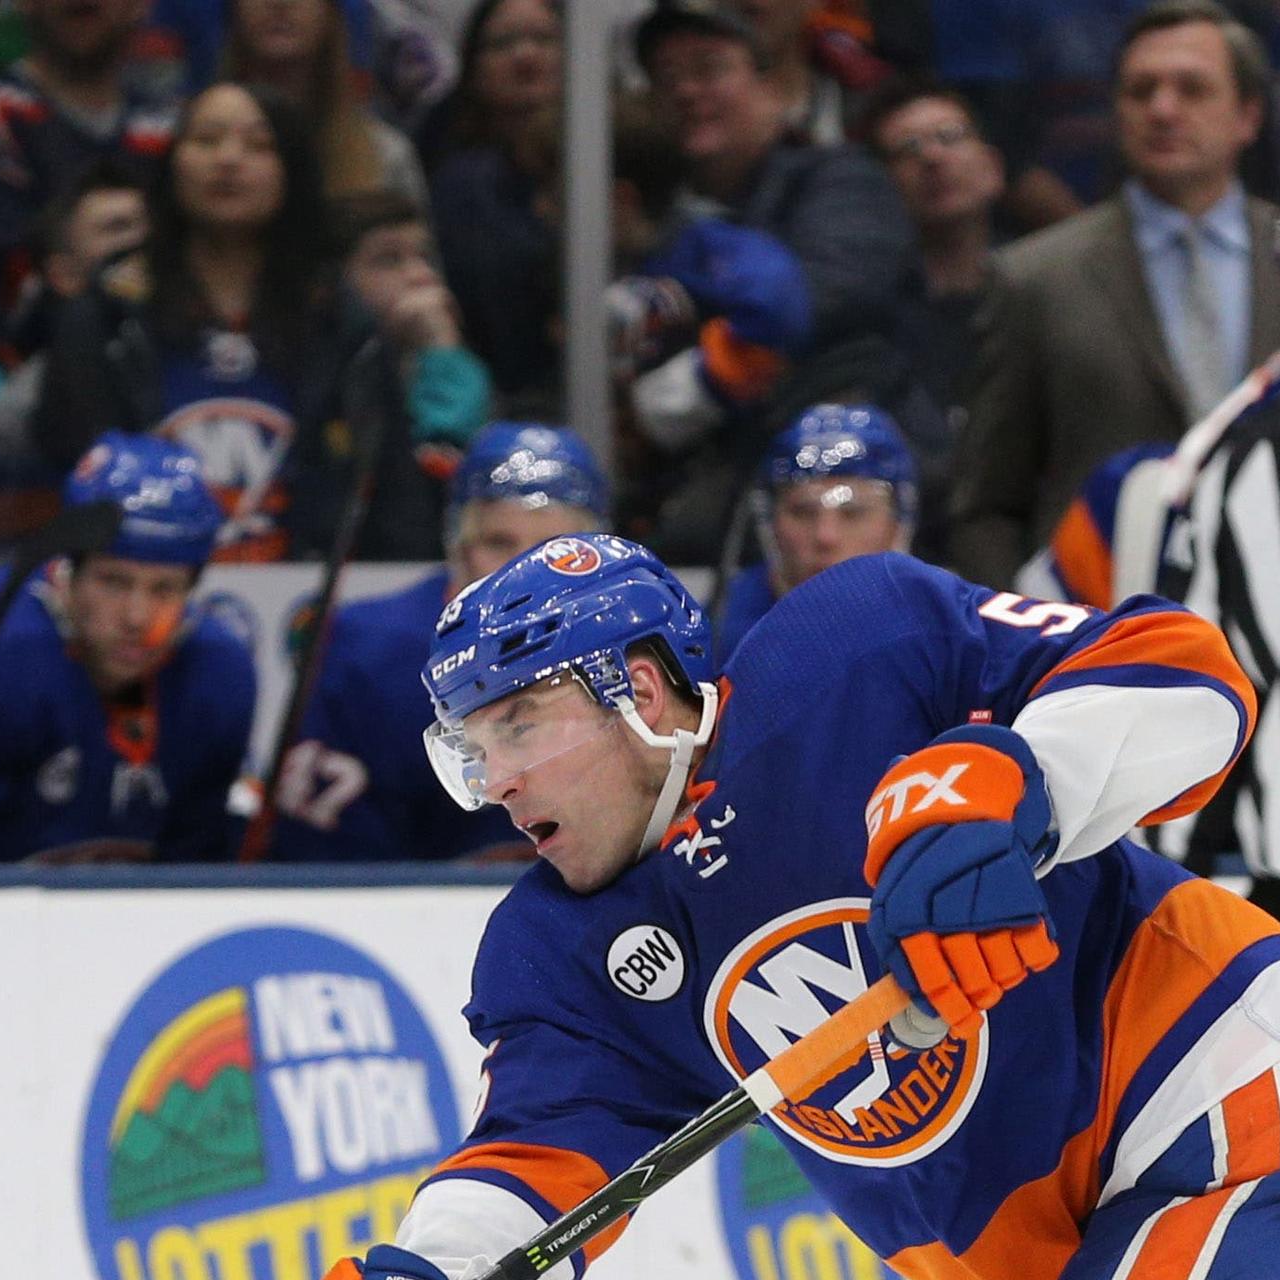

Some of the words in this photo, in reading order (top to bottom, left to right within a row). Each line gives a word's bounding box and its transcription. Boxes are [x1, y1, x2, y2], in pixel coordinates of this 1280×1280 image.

[431, 645, 476, 681] CCM
[865, 763, 971, 841] STX
[614, 929, 676, 996] CBW
[254, 972, 398, 1061] NEW
[269, 1056, 441, 1181] YORK
[792, 1034, 961, 1144] ISLANDER
[545, 1213, 598, 1253] TRIGGER
